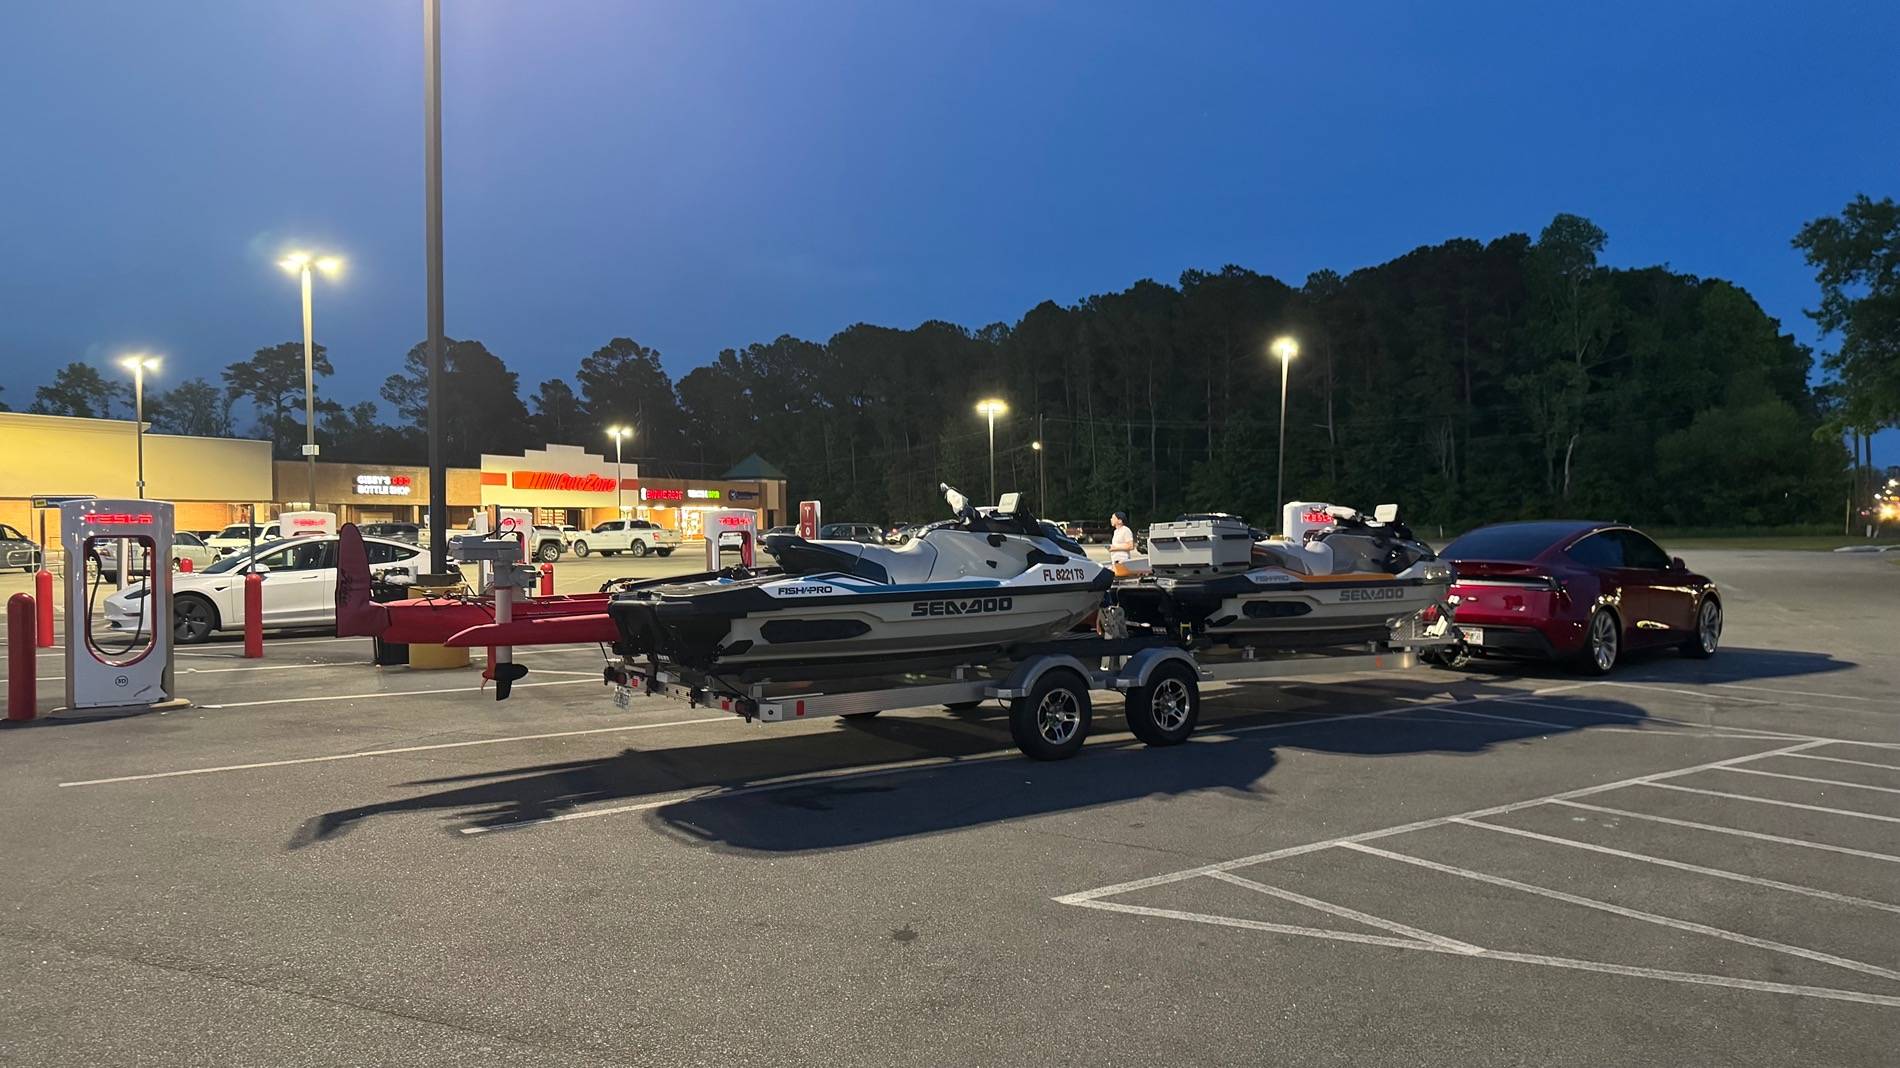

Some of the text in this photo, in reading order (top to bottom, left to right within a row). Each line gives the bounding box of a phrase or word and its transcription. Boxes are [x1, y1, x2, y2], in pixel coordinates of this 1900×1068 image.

[560, 473, 616, 492] AutoZone
[357, 485, 411, 496] BOTTLE SHOP
[84, 513, 153, 524] TESLA
[1043, 568, 1055, 582] FL
[1056, 568, 1074, 581] 8221
